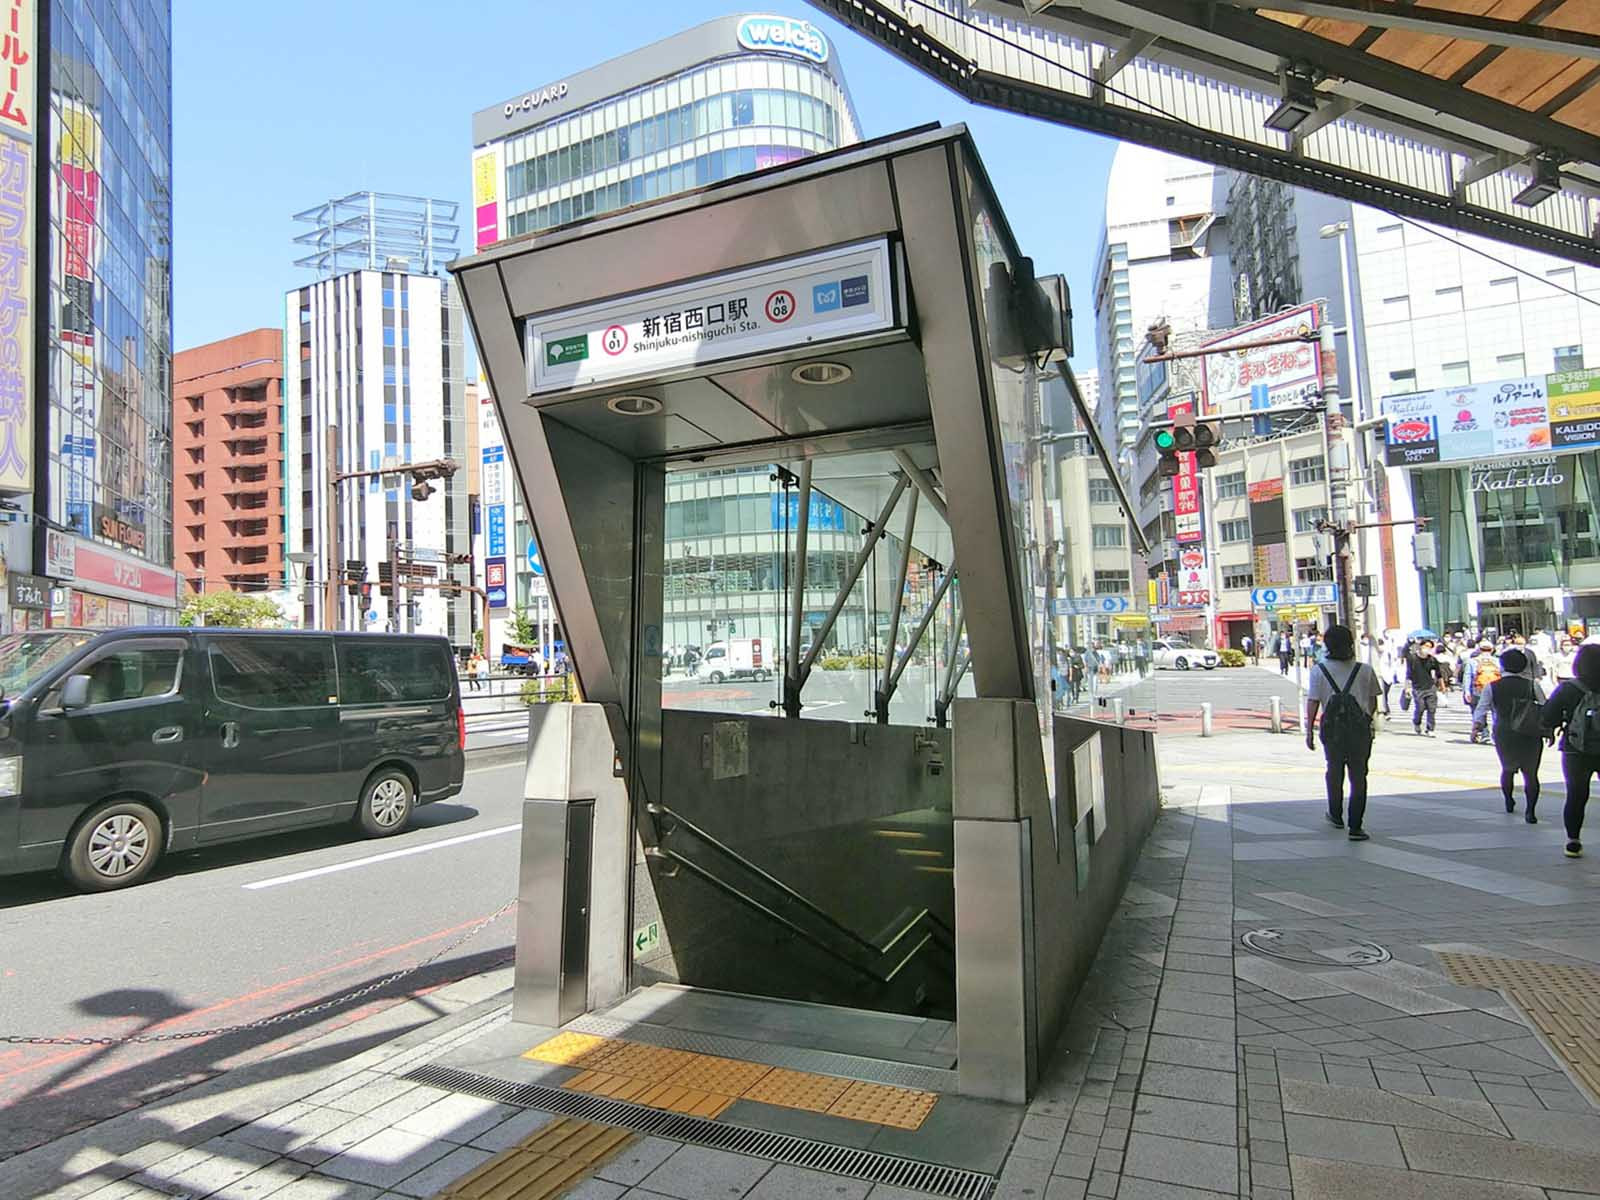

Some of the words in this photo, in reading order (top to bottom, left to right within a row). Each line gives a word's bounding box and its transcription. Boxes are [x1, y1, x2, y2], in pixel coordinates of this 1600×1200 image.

[747, 20, 822, 56] welcia
[0, 0, 29, 126] ールーム
[503, 82, 569, 118] O-GUARD
[0, 140, 28, 480] カラオケの鉄人
[773, 305, 788, 317] 08
[775, 295, 785, 304] M
[642, 297, 749, 339] 新宿西口駅
[608, 339, 621, 350] 01
[612, 330, 617, 339] E
[633, 322, 738, 353] Shinjuku-nishiguchi
[740, 320, 761, 332] Sta.
[1238, 345, 1313, 386] まねきねこ
[1493, 388, 1544, 404] ルノアール
[1563, 433, 1596, 441] VISION
[1404, 447, 1435, 457] CARROT
[1466, 464, 1564, 492] Kaleido
